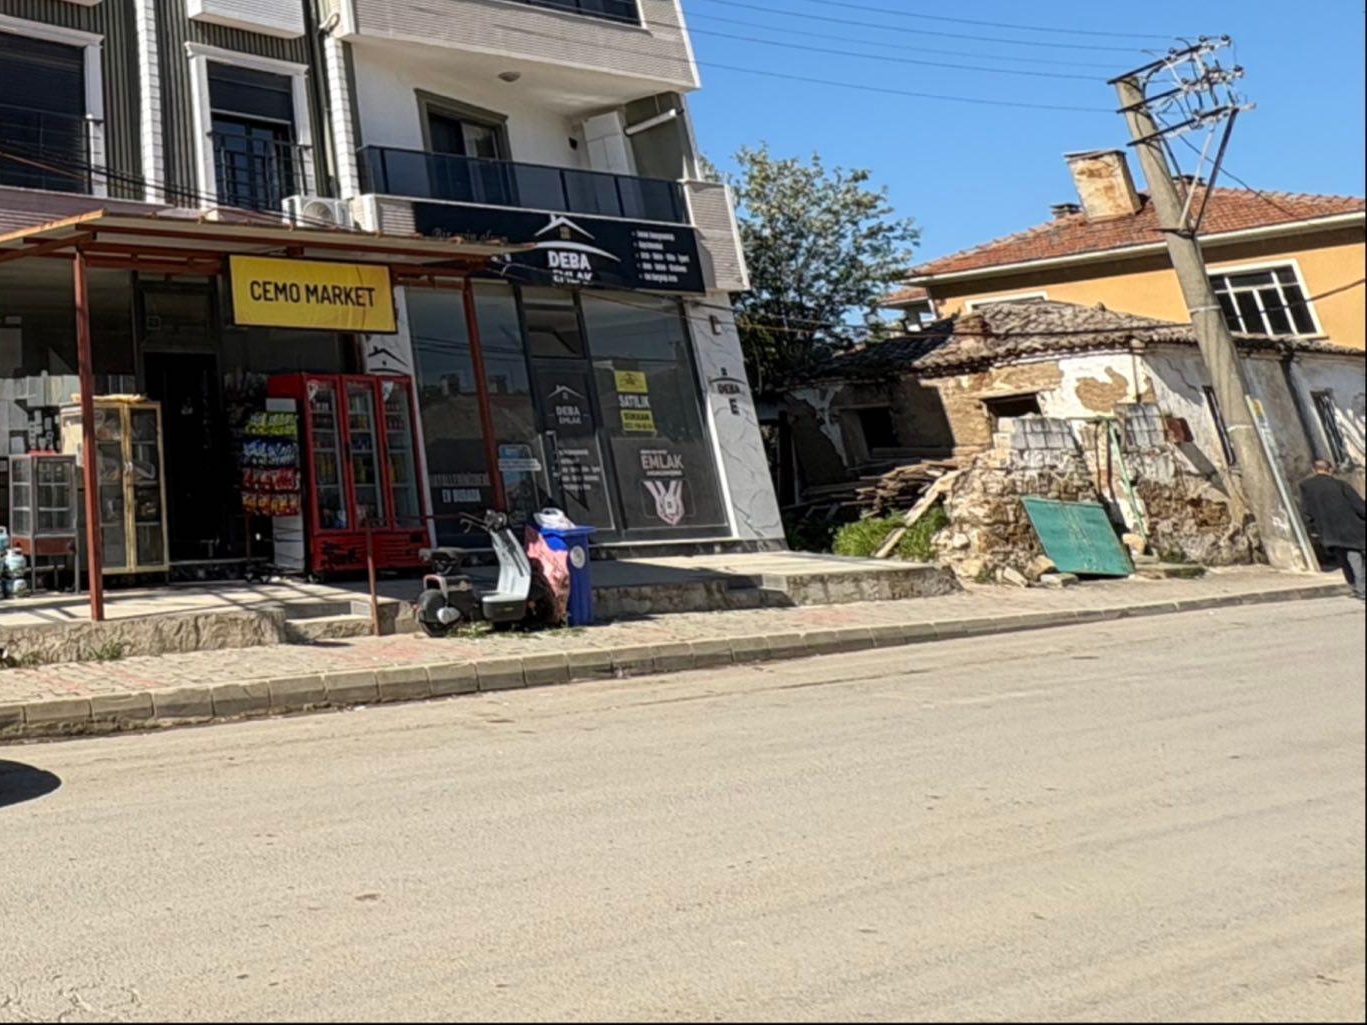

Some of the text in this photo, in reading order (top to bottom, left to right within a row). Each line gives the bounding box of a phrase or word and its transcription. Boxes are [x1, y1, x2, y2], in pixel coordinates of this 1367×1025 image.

[547, 250, 592, 271] DEBA
[250, 280, 375, 307] CEMO MARKET
[555, 405, 581, 416] DEBA
[641, 455, 685, 469] EMLAK
